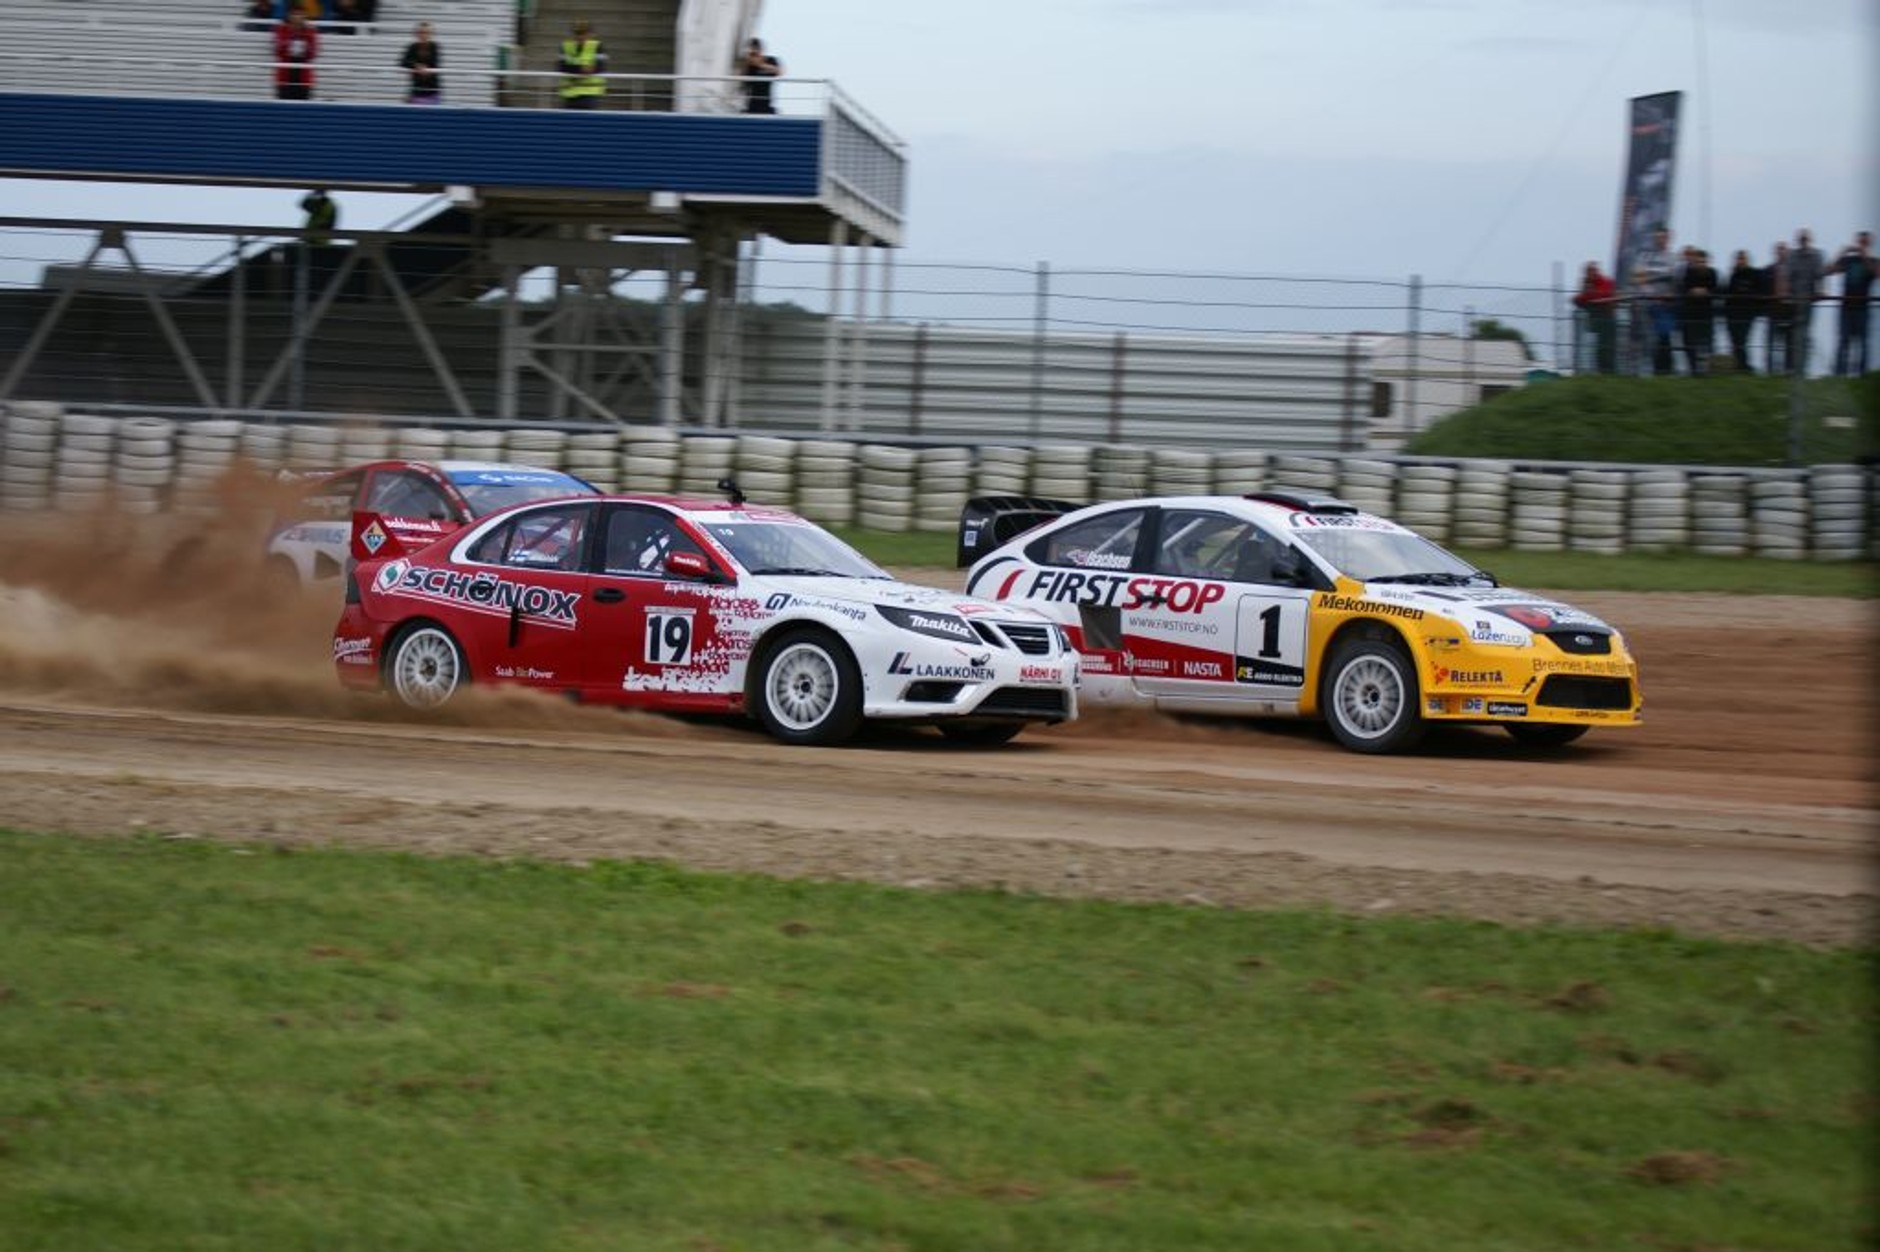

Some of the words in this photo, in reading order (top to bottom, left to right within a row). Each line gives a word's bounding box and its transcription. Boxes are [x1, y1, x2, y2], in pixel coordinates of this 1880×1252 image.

[403, 566, 580, 621] SCHÖNOX
[1318, 594, 1425, 620] Mekonomen
[1128, 616, 1218, 635] WWW.FIRSTSTOP.NO
[1258, 604, 1281, 658] 1
[648, 614, 690, 662] 19
[496, 665, 515, 677] Saab
[916, 663, 995, 681] LAAKKONEN
[1184, 661, 1222, 677] NASTA
